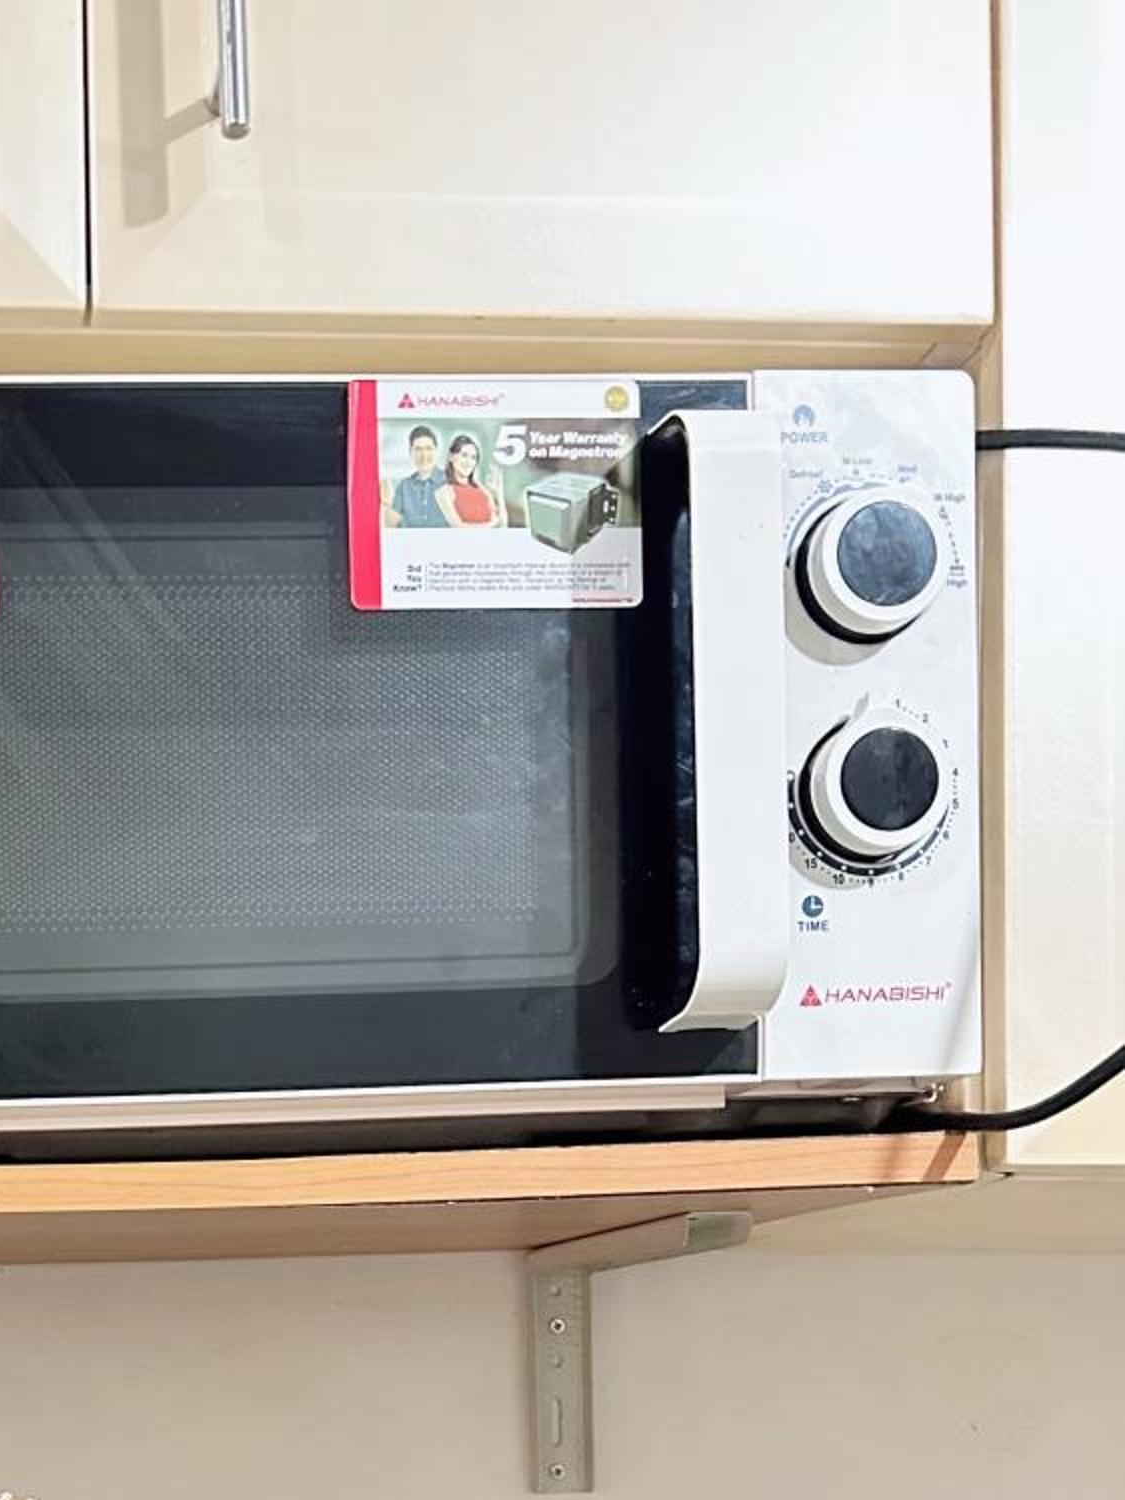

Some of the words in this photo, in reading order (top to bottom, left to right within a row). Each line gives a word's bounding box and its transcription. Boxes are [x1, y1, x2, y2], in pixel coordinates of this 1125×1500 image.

[417, 395, 498, 407] HANABISHI
[529, 431, 560, 445] Year
[562, 431, 627, 446] Warranty
[780, 432, 828, 443] POWER
[492, 425, 527, 465] 5
[528, 447, 547, 459] on
[804, 858, 818, 869] 15
[797, 921, 829, 931] TIME
[825, 987, 946, 1003] HANABISHI
